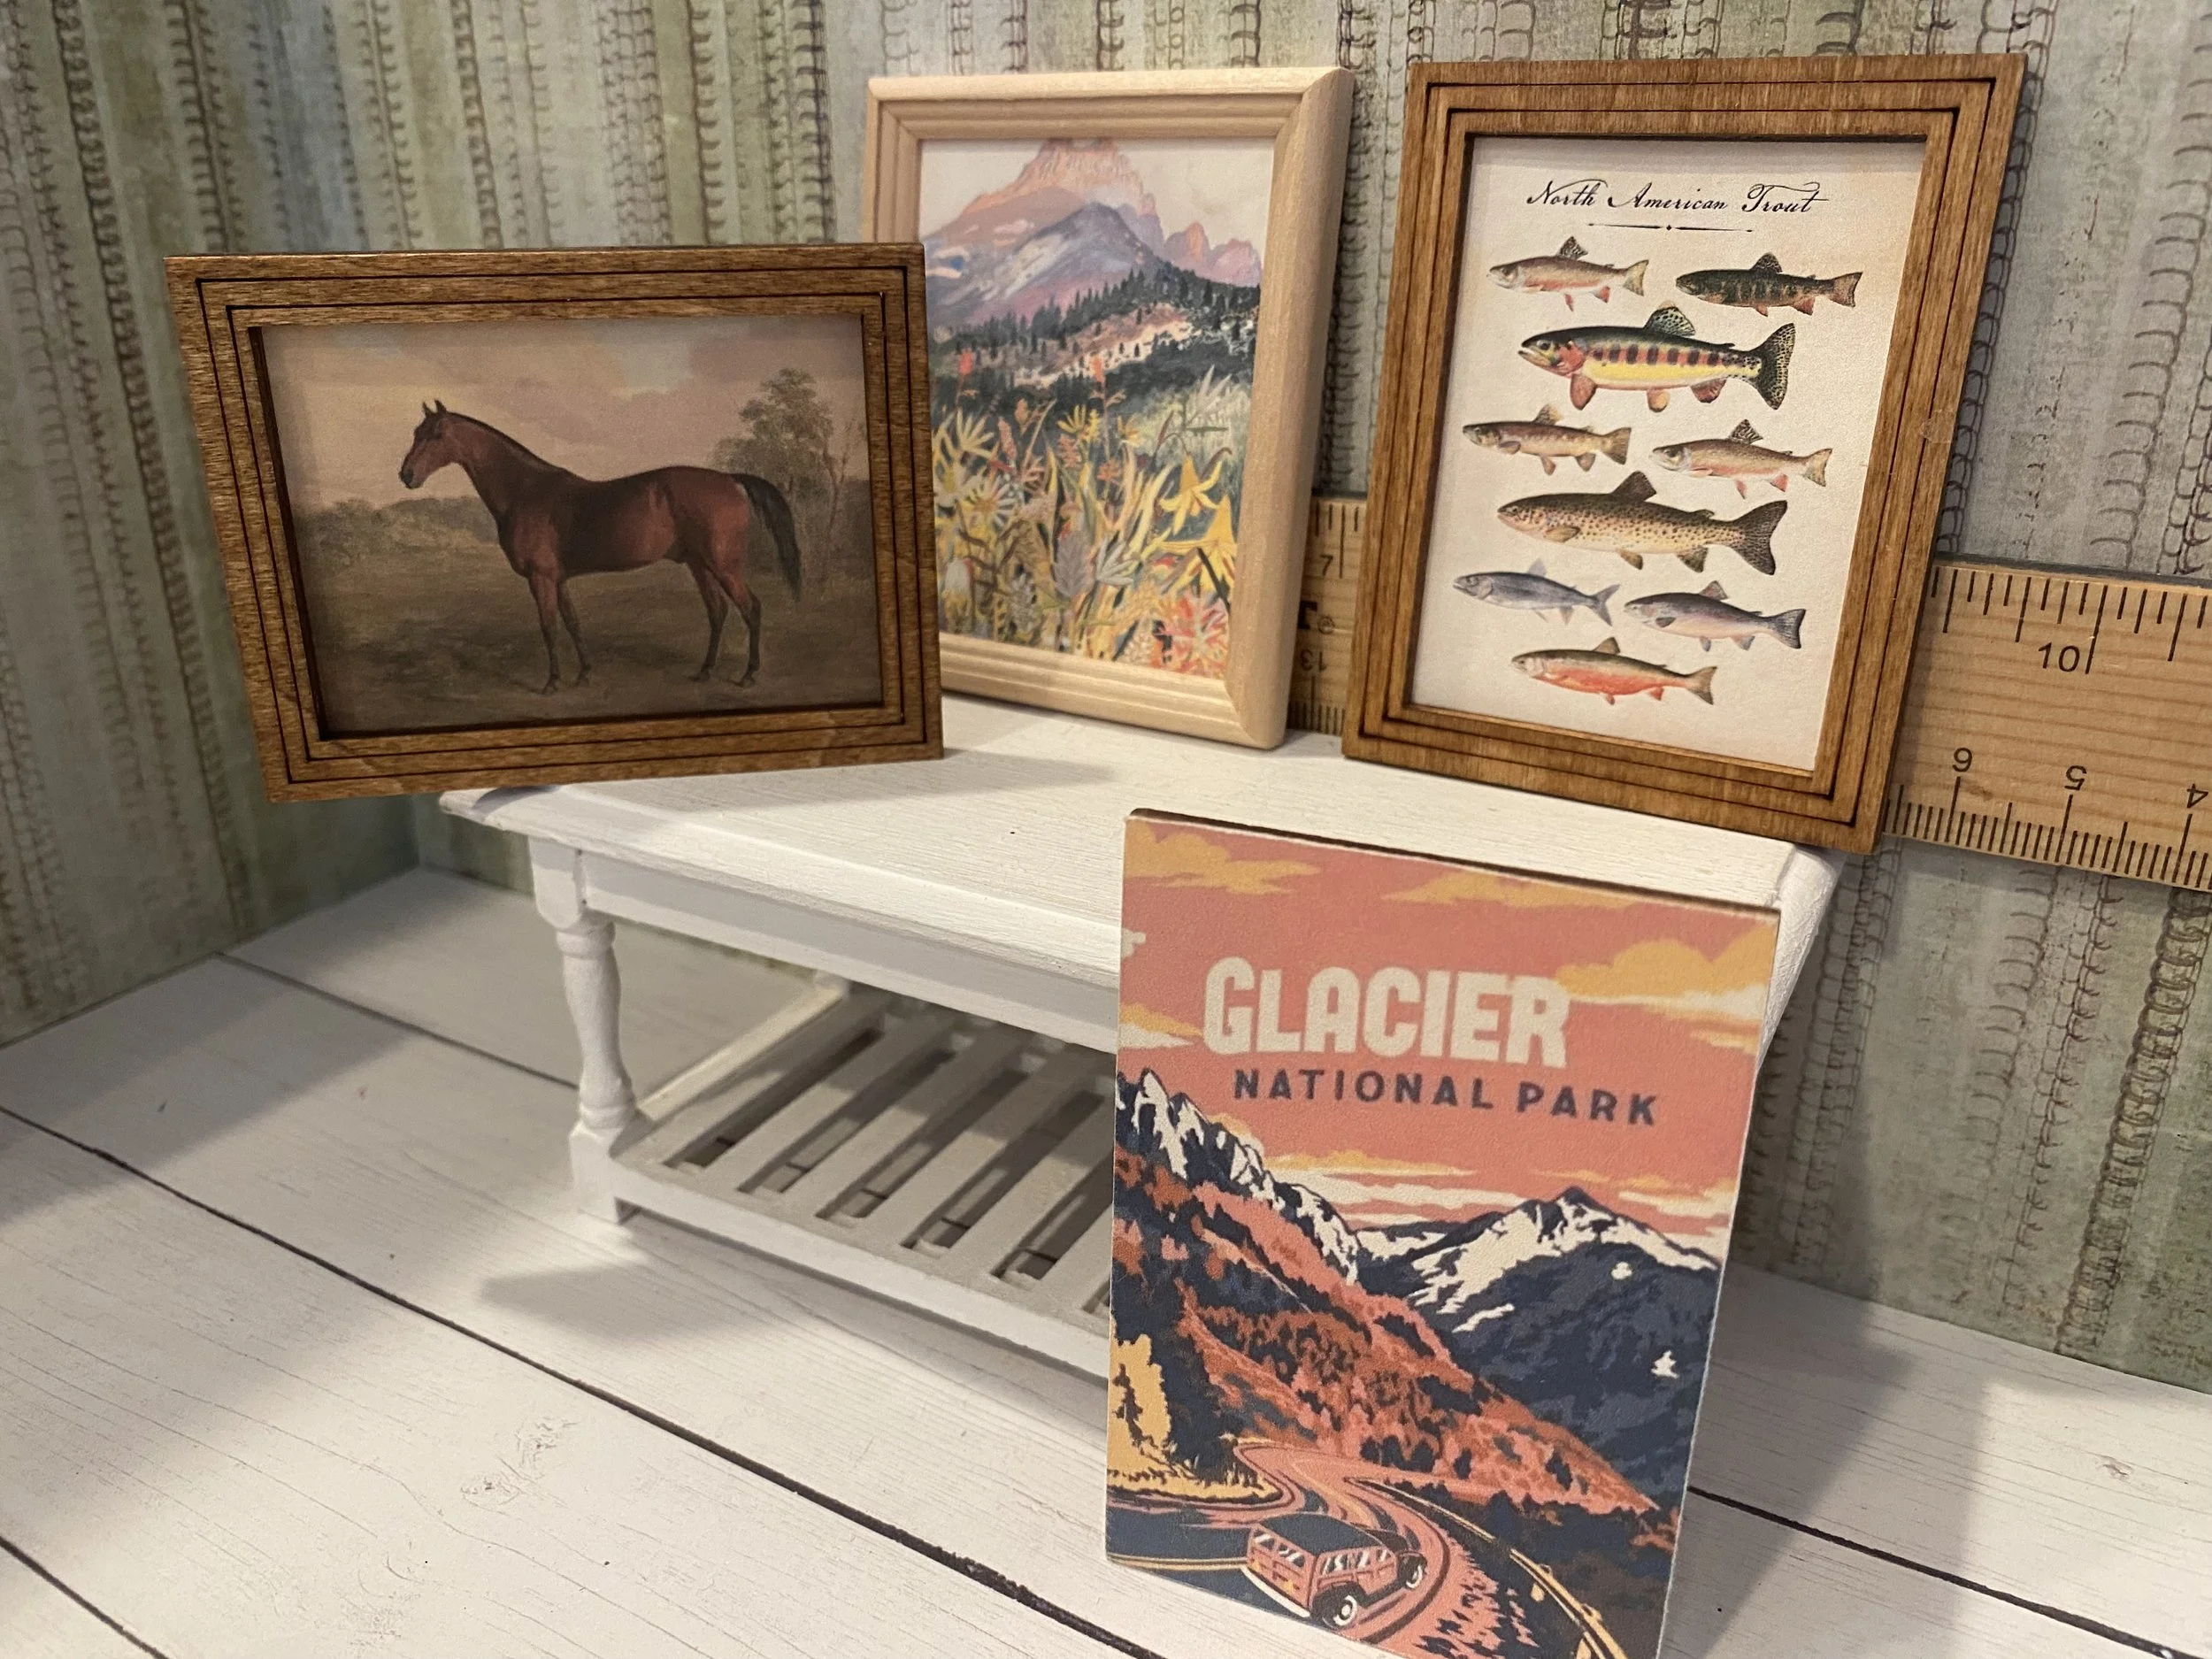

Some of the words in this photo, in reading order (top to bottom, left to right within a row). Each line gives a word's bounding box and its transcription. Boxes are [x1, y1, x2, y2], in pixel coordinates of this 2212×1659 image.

[1525, 178, 1608, 207] North
[1608, 180, 1729, 211] American
[1740, 180, 1830, 213] Trout
[1319, 555, 1334, 576] 7
[1299, 649, 1327, 672] 13
[2038, 641, 2081, 673] 10
[1951, 747, 1973, 773] 6
[2063, 764, 2087, 792] 5
[2186, 783, 2209, 809] 4
[1202, 956, 1571, 1069] GLACIER
[1233, 1068, 1494, 1110] NATIONAL
[1517, 1081, 1657, 1126] PARK
